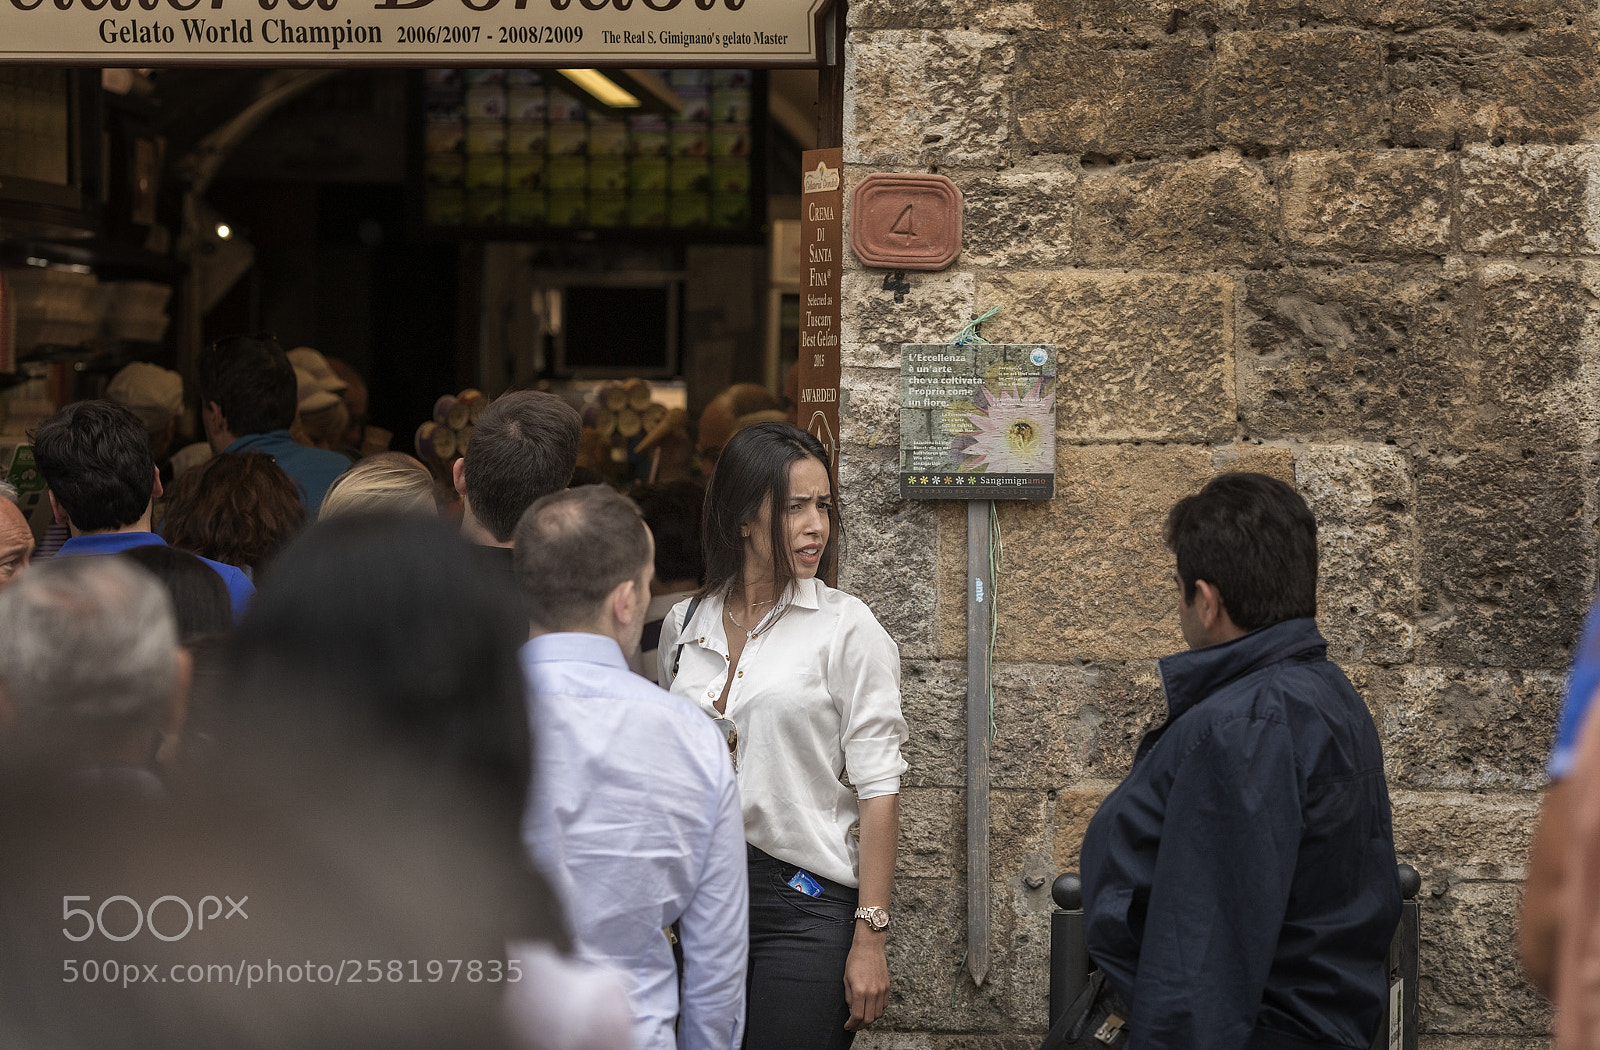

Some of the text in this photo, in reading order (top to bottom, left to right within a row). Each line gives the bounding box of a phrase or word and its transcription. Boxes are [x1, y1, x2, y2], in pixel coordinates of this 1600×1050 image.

[99, 18, 382, 50] Gelato World Champion
[396, 25, 481, 44] 2006/2007
[498, 25, 584, 44] 2008/2009
[602, 30, 789, 49] The Real S. Gimignano's gelato Master
[889, 203, 919, 247] 4
[807, 293, 833, 306] Selected as
[806, 311, 832, 332] Tuscany
[802, 330, 838, 347] Best Gelato
[813, 354, 825, 367] 2015
[908, 353, 966, 362] L'Eccellenza
[908, 365, 953, 373] è un'arte
[908, 376, 926, 384] che
[940, 376, 986, 385] coltivata.
[801, 387, 837, 403] AWARDED
[908, 387, 973, 398] Proprio come
[908, 398, 950, 407] un fiore.
[980, 476, 1046, 486] Sangimignamo
